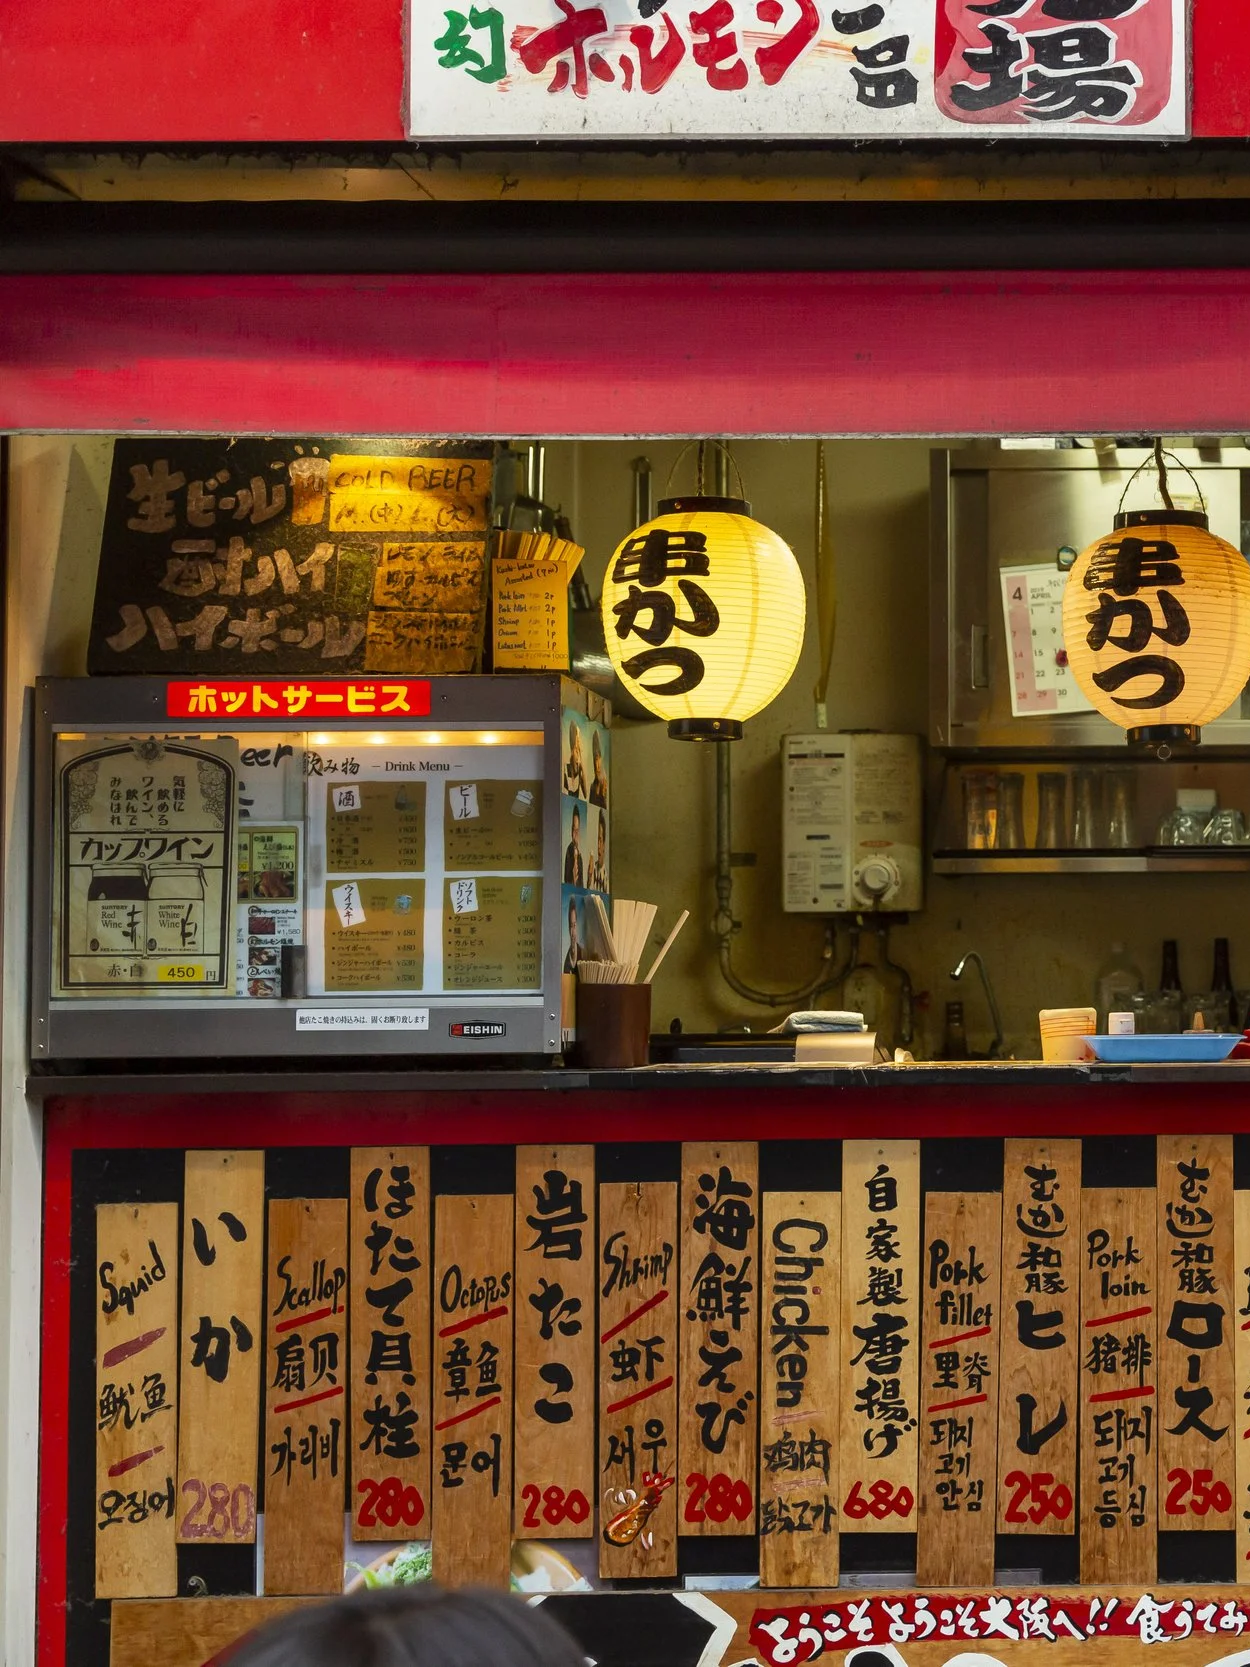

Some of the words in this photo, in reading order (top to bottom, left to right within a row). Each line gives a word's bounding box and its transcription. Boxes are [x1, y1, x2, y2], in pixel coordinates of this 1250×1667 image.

[519, 0, 826, 99] ホルモン
[127, 459, 287, 533] 生ビール
[335, 470, 394, 489] COLD
[408, 465, 476, 492] BEER
[158, 536, 336, 597] 酎ハイ
[611, 528, 721, 697] 串かつ
[1012, 587, 1022, 600] 4
[106, 604, 366, 658] ハイボール
[1082, 537, 1191, 710] 串かつ
[188, 685, 411, 713] ホットサービス
[385, 760, 416, 773] Drink
[419, 760, 451, 773] Menu
[110, 776, 122, 826] みなはれ
[125, 788, 138, 826] 飲んで
[157, 788, 170, 826] 飲める
[173, 775, 186, 812] 気軽に
[338, 790, 355, 807] 酒
[459, 784, 472, 818] ビール
[80, 837, 214, 861] カップワイン
[101, 911, 116, 919] Red
[101, 920, 122, 928] Wine
[158, 911, 181, 919] White
[158, 920, 180, 928] Wine
[343, 884, 354, 925] ウイスキー
[167, 967, 195, 978] 450
[205, 971, 217, 981] 円
[463, 1026, 503, 1034] EISHIN
[602, 1230, 674, 1299] Shrimp
[928, 1239, 991, 1290] Pork
[1086, 1228, 1144, 1273] Pork
[99, 1239, 166, 1316] Squid
[191, 1212, 253, 1383] いか
[272, 1255, 346, 1316] Scallop
[523, 1169, 588, 1424] 岩たこ
[1100, 1272, 1152, 1300] loin
[359, 1165, 421, 1459] ほたて貝柱
[685, 1165, 756, 1454] 海鮮えび
[770, 1218, 831, 1410] Chicken
[849, 1164, 919, 1459] 自家製唐揚げ
[935, 1290, 993, 1327] fillet
[271, 1332, 340, 1393] 扇贝
[441, 1338, 502, 1400] 章鱼
[609, 1334, 666, 1382] 虾
[932, 1350, 991, 1394] 里脊
[1083, 1332, 1152, 1389] 猪排
[98, 1373, 173, 1432] 鱿鱼
[270, 1418, 340, 1486] 가리비
[603, 1418, 668, 1484] 새우
[928, 1416, 973, 1450] 돼지
[1093, 1405, 1152, 1457] 돼지
[439, 1433, 502, 1497] 문어
[762, 1428, 833, 1487] 鸡肉
[934, 1452, 971, 1479] 고기
[1097, 1454, 1136, 1486] 고기
[98, 1477, 174, 1529] 오징어
[180, 1478, 255, 1539] 280
[357, 1476, 425, 1527] 280
[521, 1483, 591, 1528] 280
[685, 1473, 753, 1524] 280
[843, 1480, 914, 1521] 680
[935, 1479, 985, 1513] 안심
[1004, 1469, 1074, 1526] 250
[1094, 1483, 1148, 1529] 등심
[1164, 1467, 1233, 1517] 250
[757, 1595, 1121, 1664] ようこそようこそ大阪へ!!
